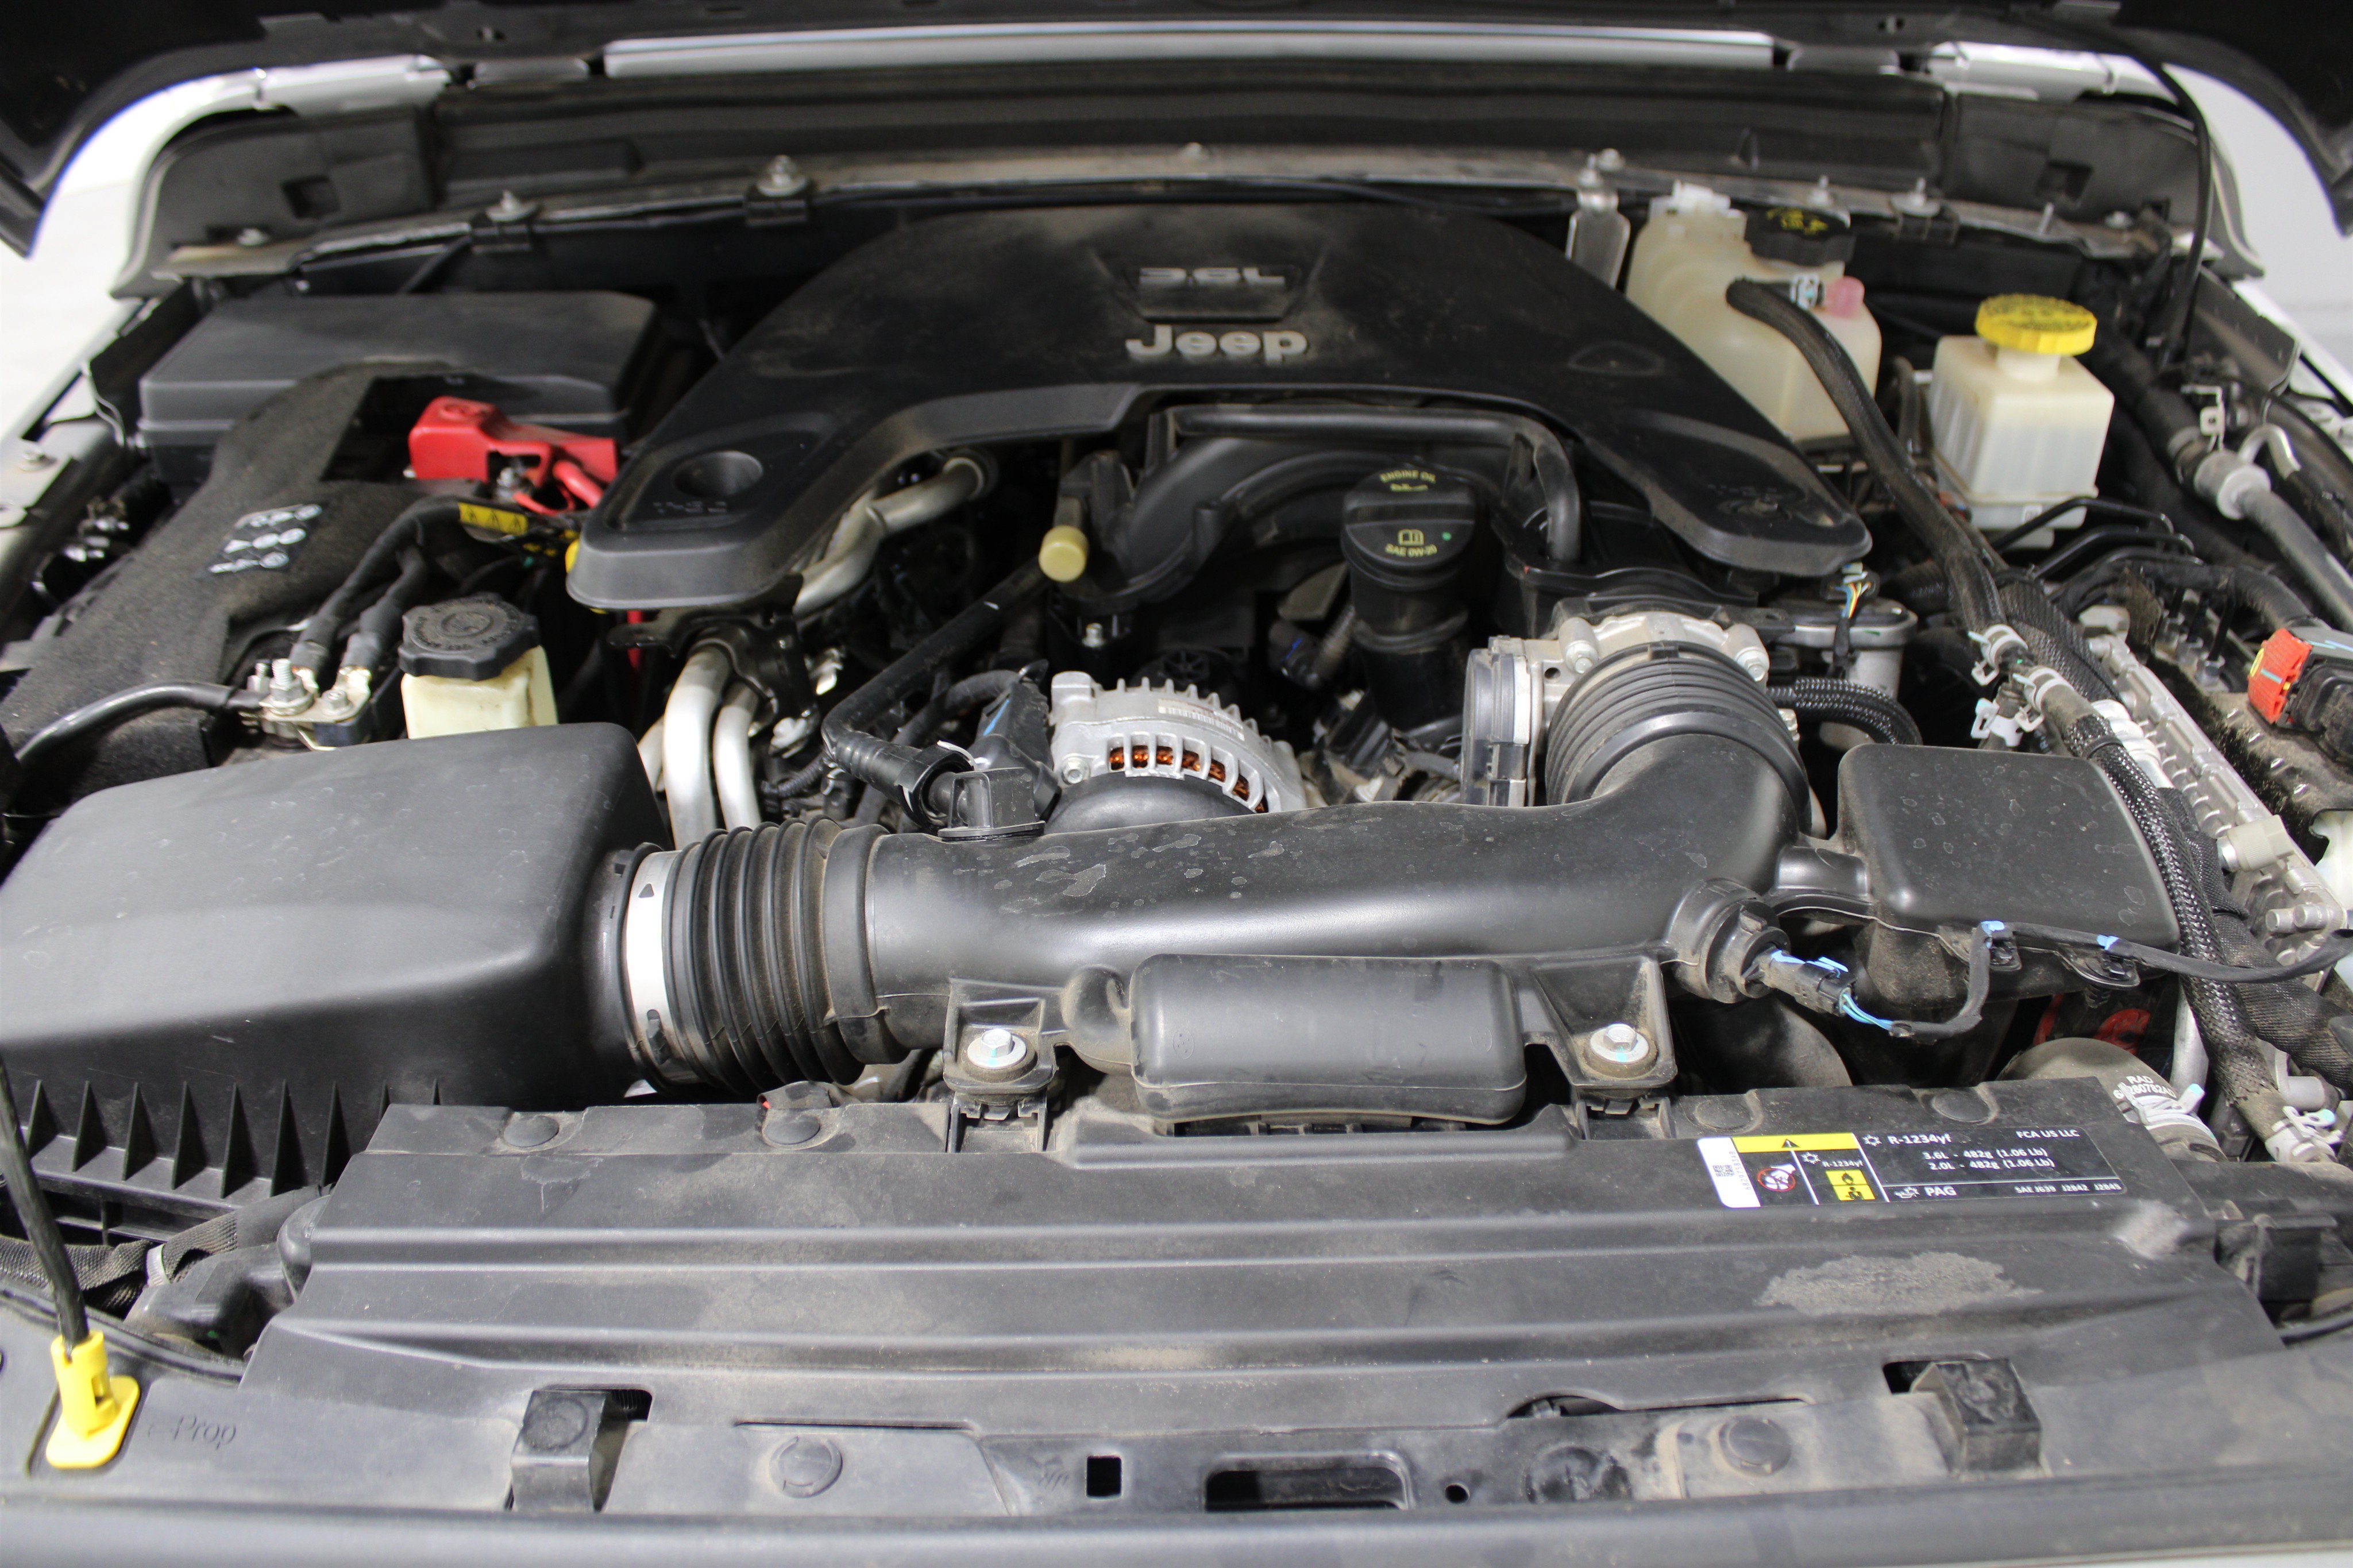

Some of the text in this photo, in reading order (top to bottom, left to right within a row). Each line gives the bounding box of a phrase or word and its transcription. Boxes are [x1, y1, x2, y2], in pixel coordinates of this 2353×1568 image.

[1124, 325, 1308, 366] Jeep
[1384, 543, 1407, 557] SAE
[2126, 1075, 2154, 1084] RAD
[1887, 1133, 1952, 1145] R-1234yf
[2015, 1129, 2080, 1138] FCA US LLC
[1921, 1150, 1950, 1160] 3.6L
[1963, 1149, 1995, 1159] 482g
[1996, 1148, 2028, 1158] (1.06
[2027, 1147, 2049, 1157] Lb)
[1822, 1159, 1864, 1168] R-1234yf
[1928, 1161, 1956, 1170] 2.0L
[1969, 1160, 2001, 1170] 482g
[2002, 1158, 2035, 1169] (1.06
[2034, 1157, 2055, 1168] Lb)
[1923, 1185, 1957, 1196] PAG
[2014, 1182, 2123, 1194] SAE J639 J2842 J2845
[173, 1415, 237, 1450] Prop
